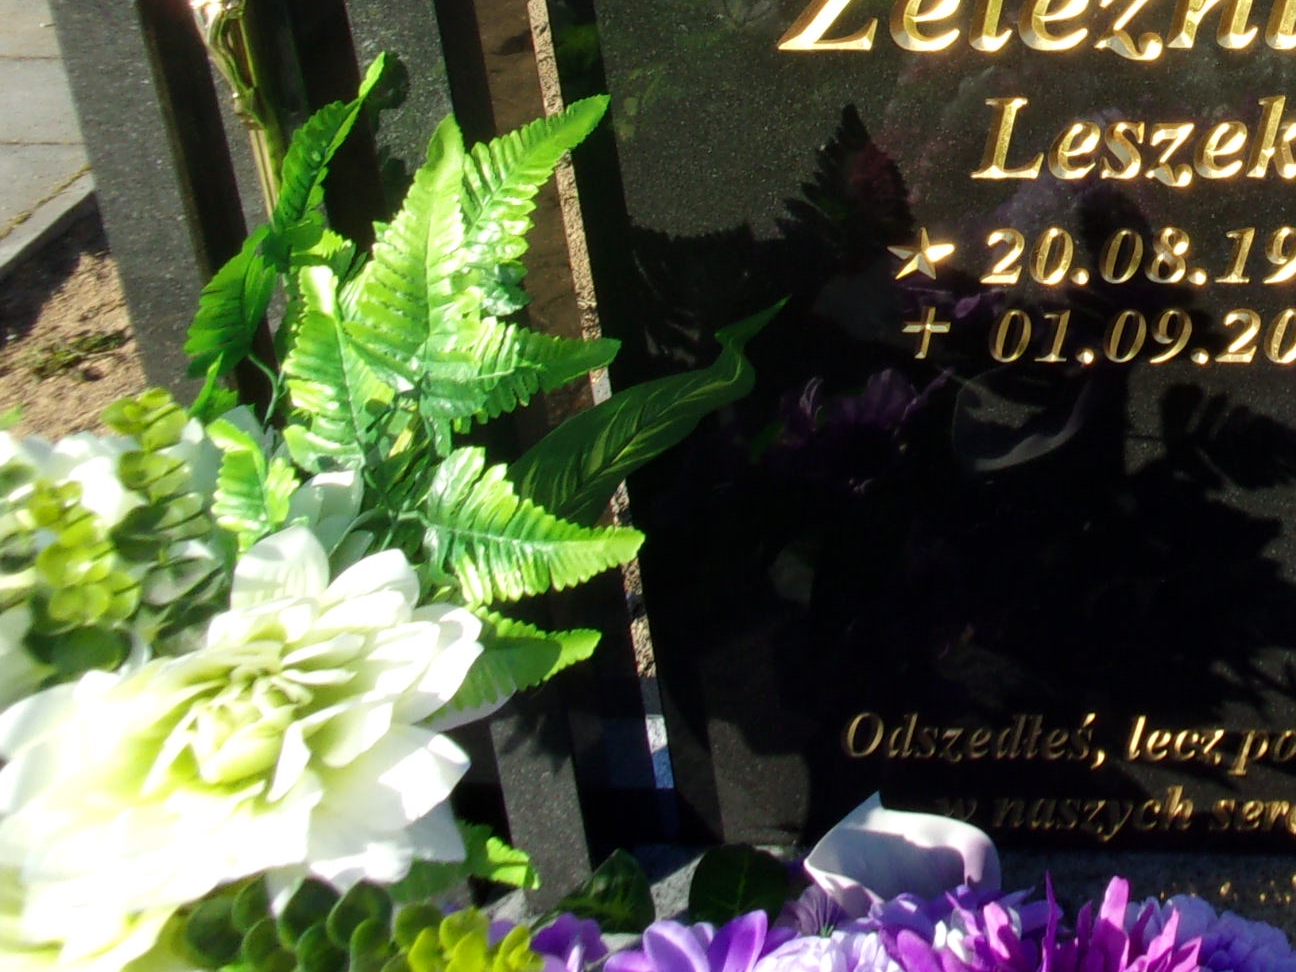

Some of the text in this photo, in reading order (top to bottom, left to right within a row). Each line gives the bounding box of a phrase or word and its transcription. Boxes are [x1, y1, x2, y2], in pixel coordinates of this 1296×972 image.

[841, 710, 1108, 770] Odszedłeś,
[1127, 714, 1225, 768] lecz
[993, 785, 1195, 841] naszych
